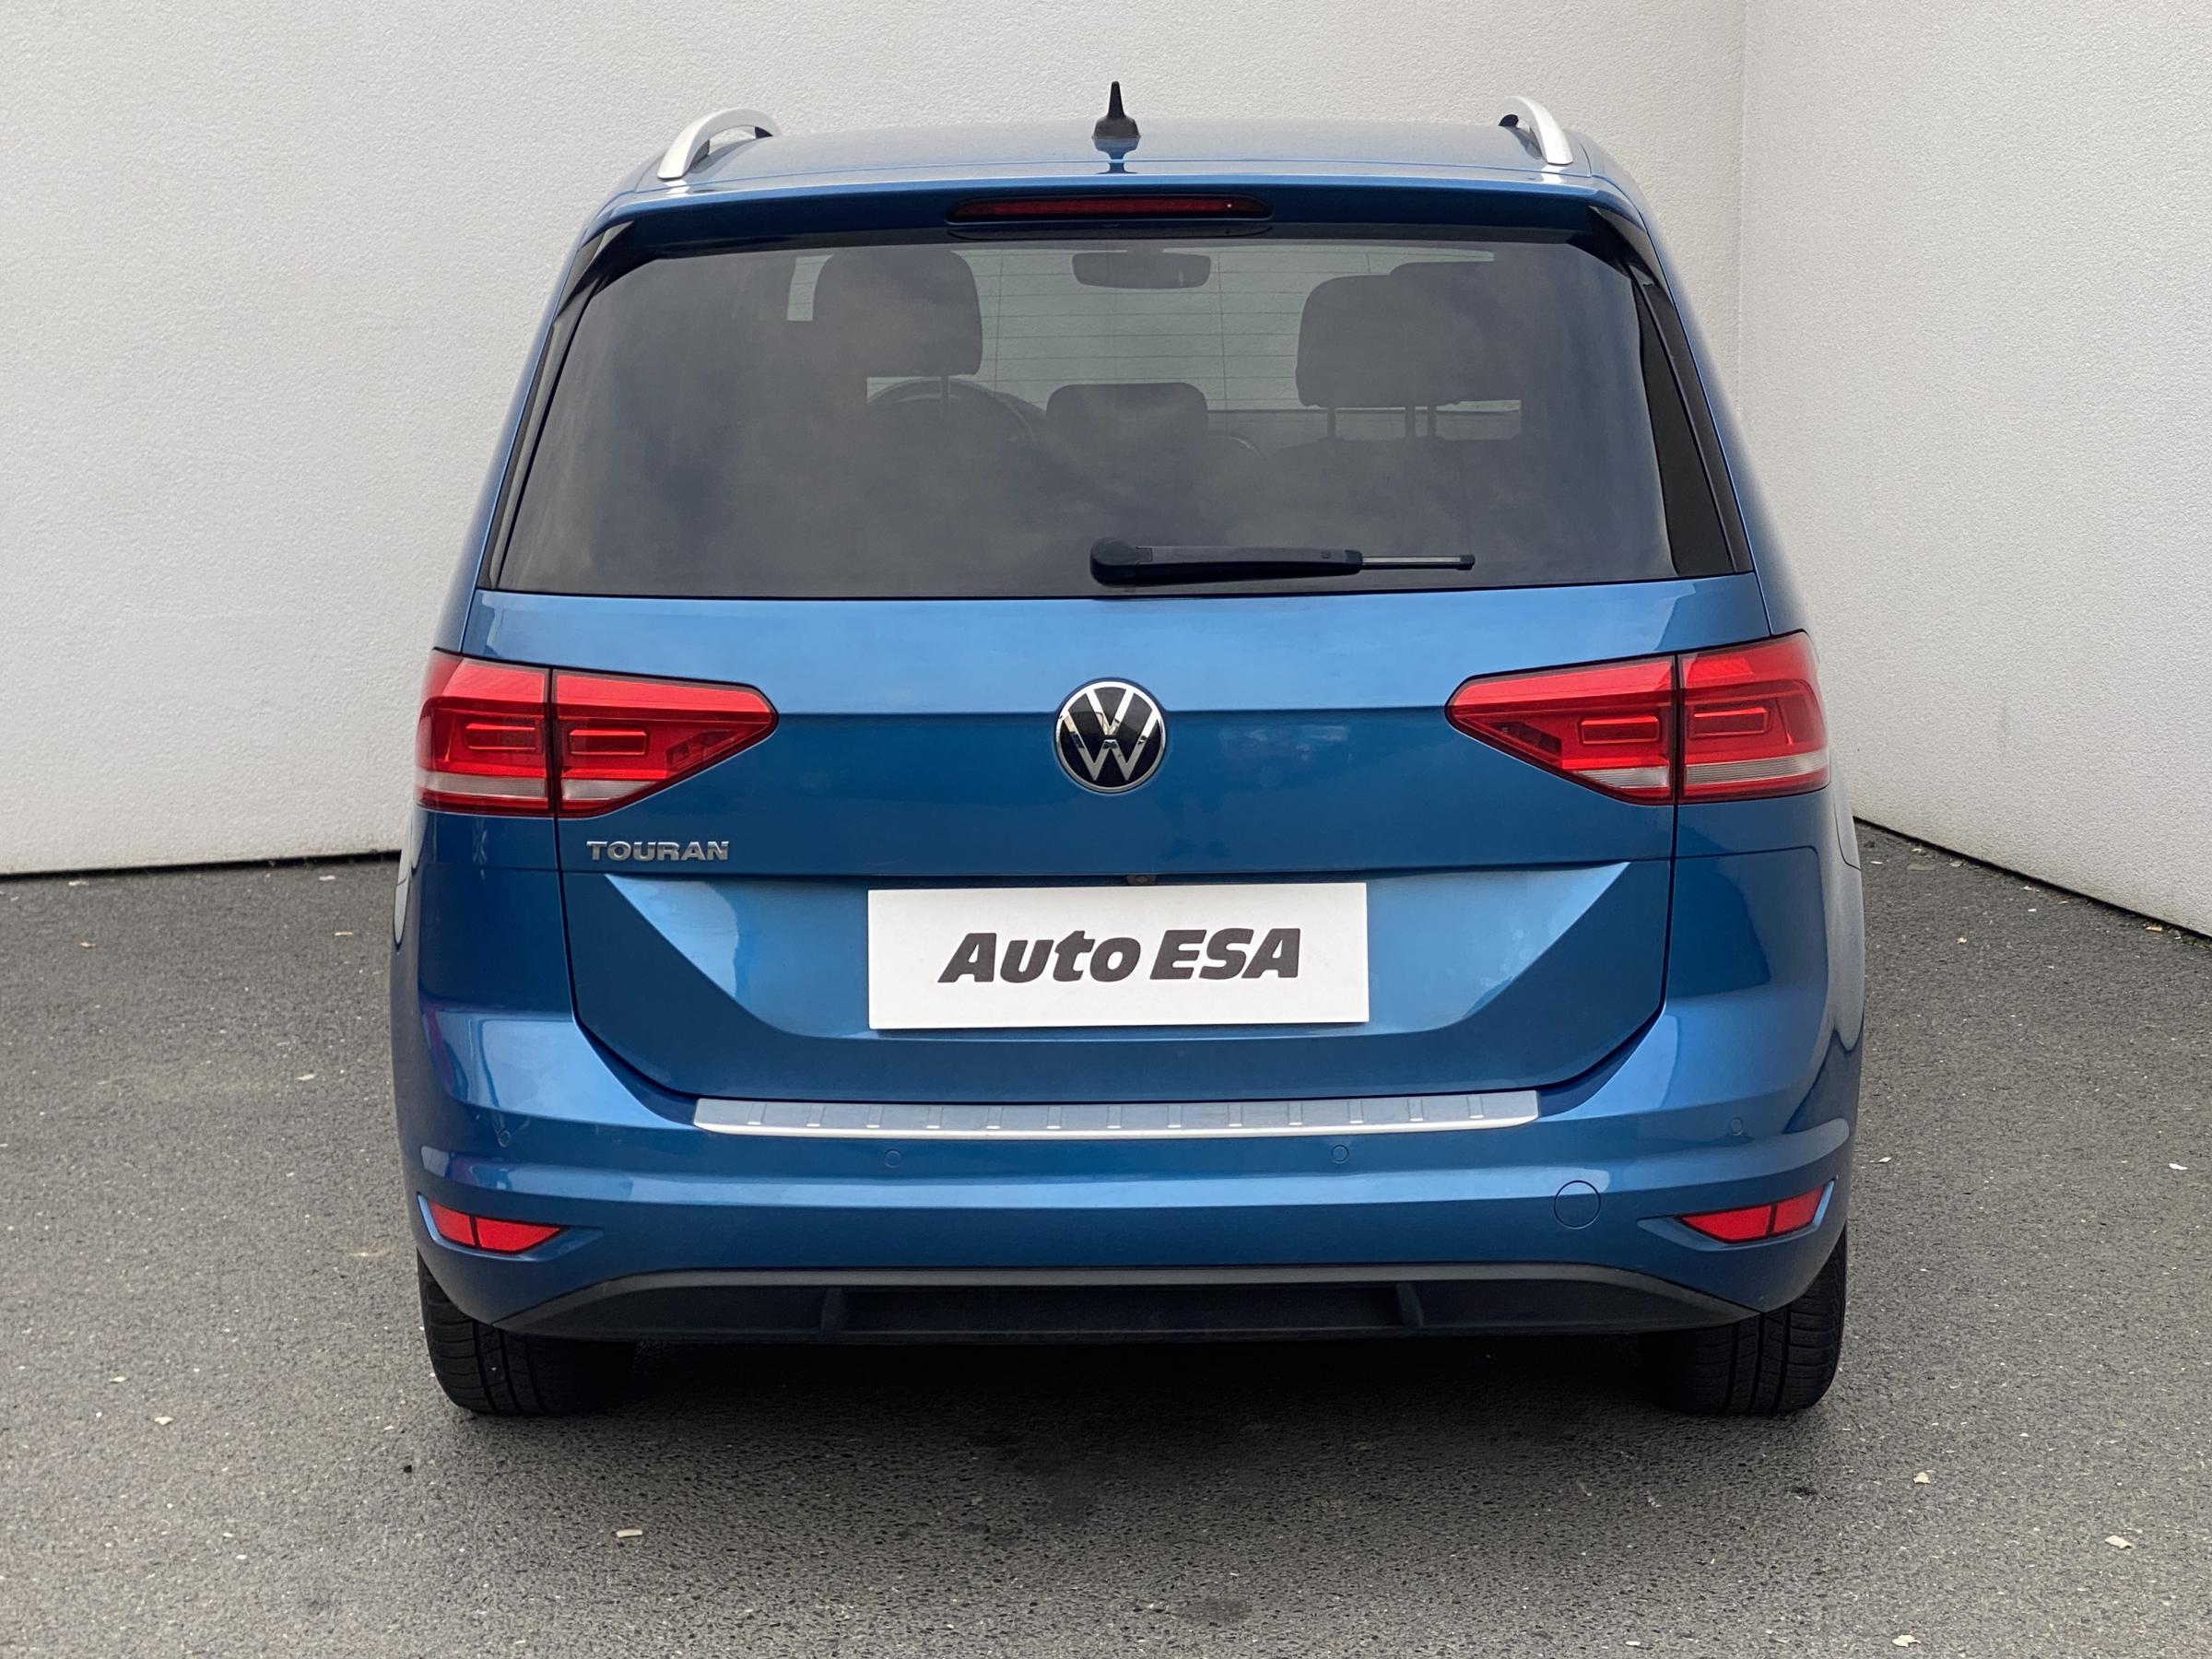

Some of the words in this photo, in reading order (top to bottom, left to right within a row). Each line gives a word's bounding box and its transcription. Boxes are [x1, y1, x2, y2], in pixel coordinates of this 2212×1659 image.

[586, 841, 729, 861] TOURAN
[937, 930, 1141, 983] Auto
[1149, 927, 1300, 980] ESA
